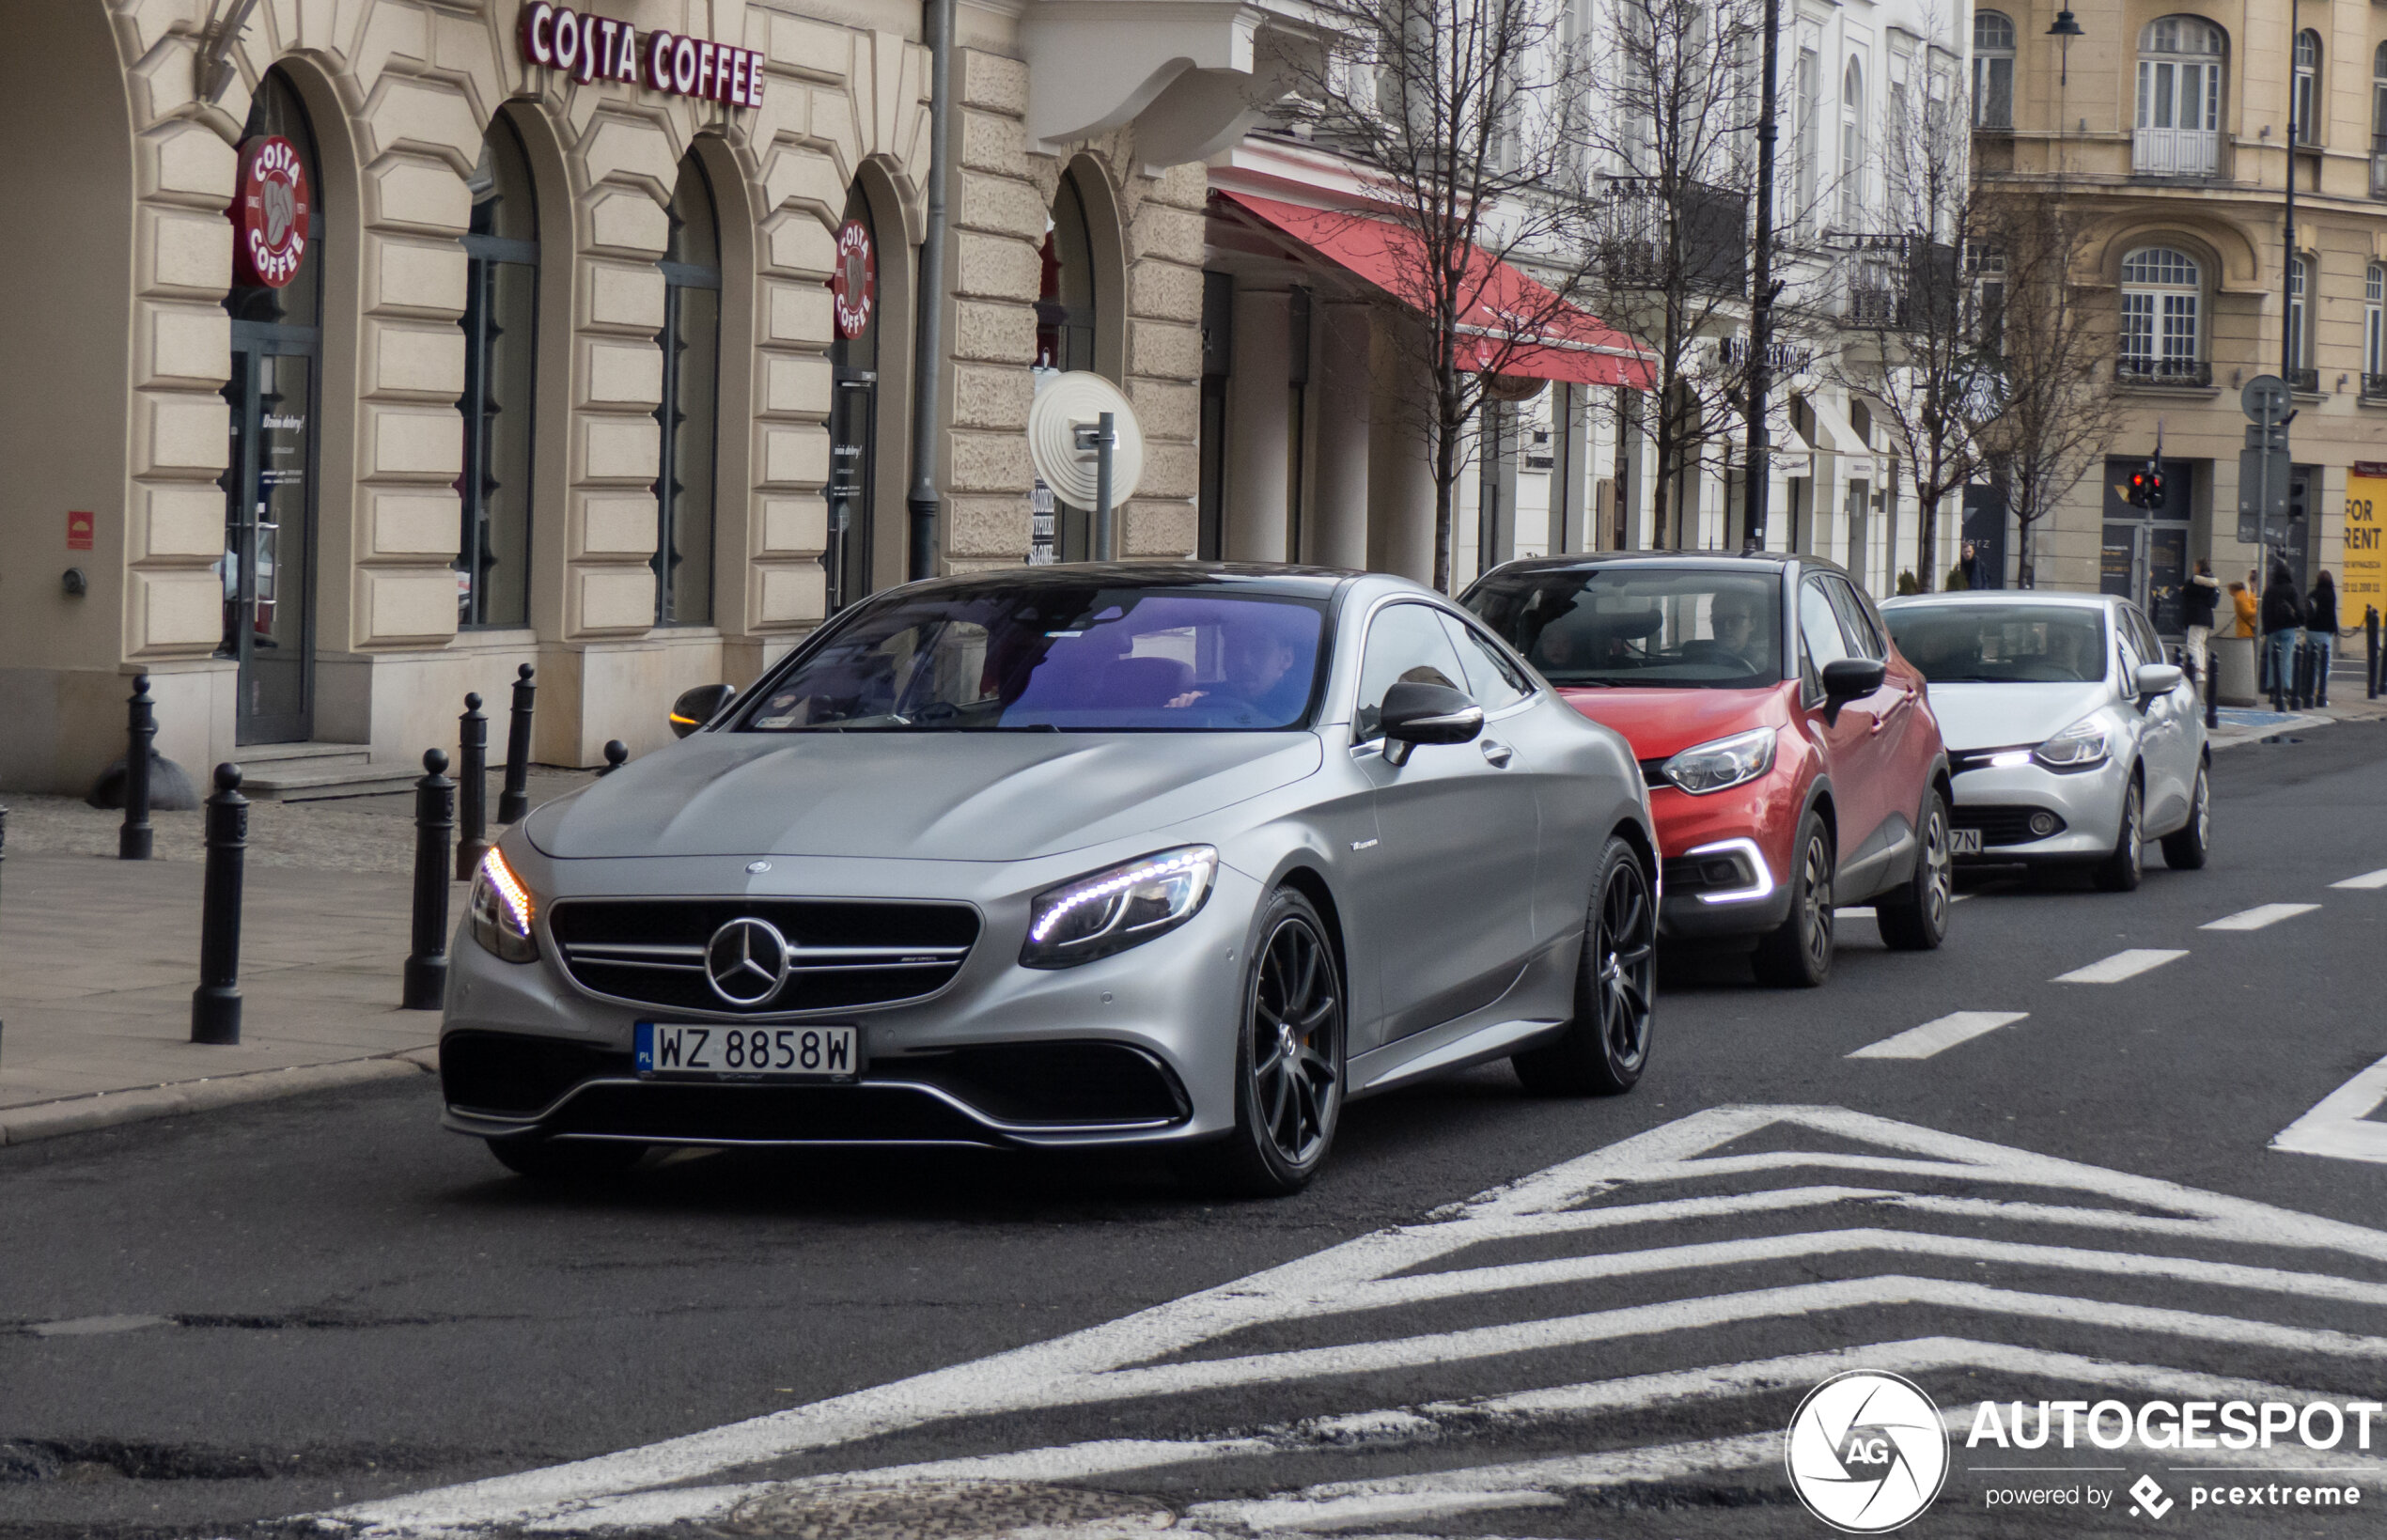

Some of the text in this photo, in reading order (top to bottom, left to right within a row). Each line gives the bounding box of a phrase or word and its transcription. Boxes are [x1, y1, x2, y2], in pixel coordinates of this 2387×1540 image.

[528, 3, 765, 108] COSTA COFFEE
[255, 143, 301, 189] COSTA
[250, 228, 304, 282] COFFEE
[840, 225, 869, 260] COSTA
[837, 293, 871, 334] COFFEE
[639, 1051, 651, 1064] PL
[660, 1028, 850, 1069] WZ 8858W
